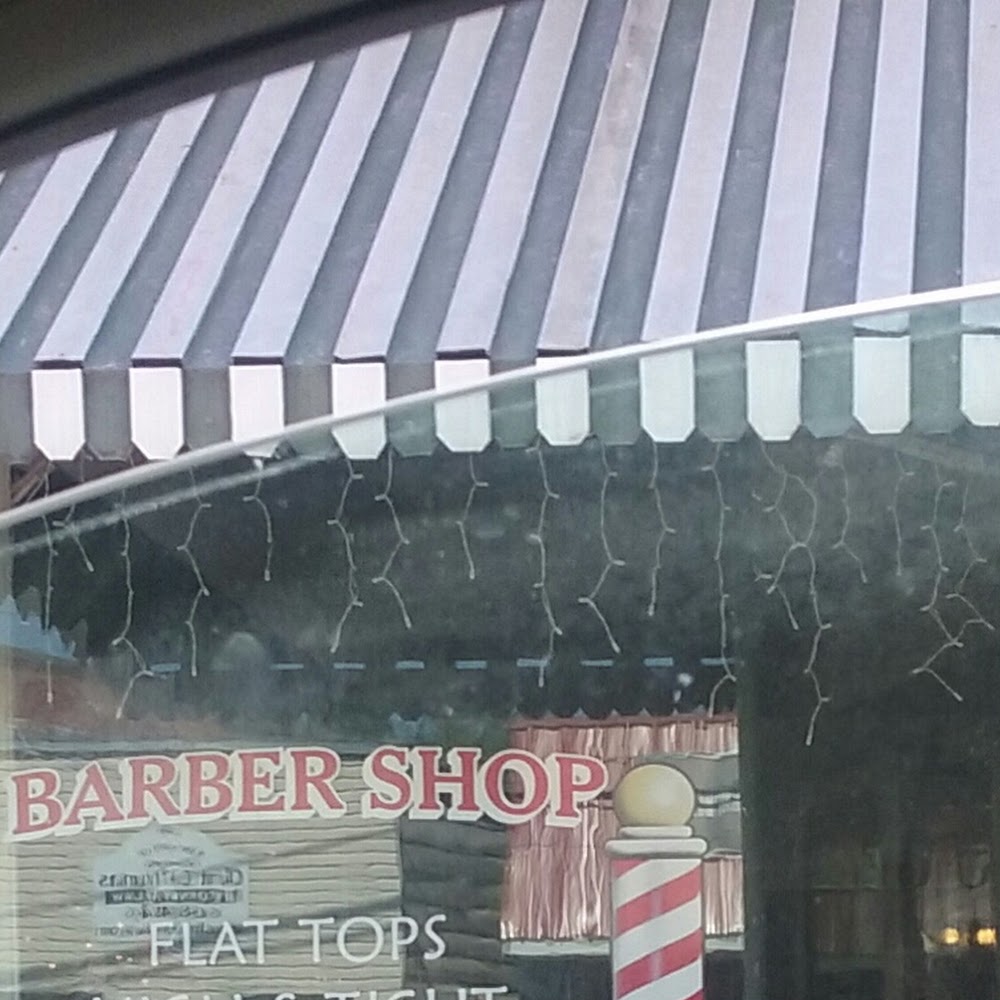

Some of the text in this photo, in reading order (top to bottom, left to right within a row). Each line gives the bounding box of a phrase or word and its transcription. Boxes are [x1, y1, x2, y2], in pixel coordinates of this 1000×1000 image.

[9, 745, 609, 841] BARBER SHOP
[150, 914, 447, 966] FLAT TOPS
